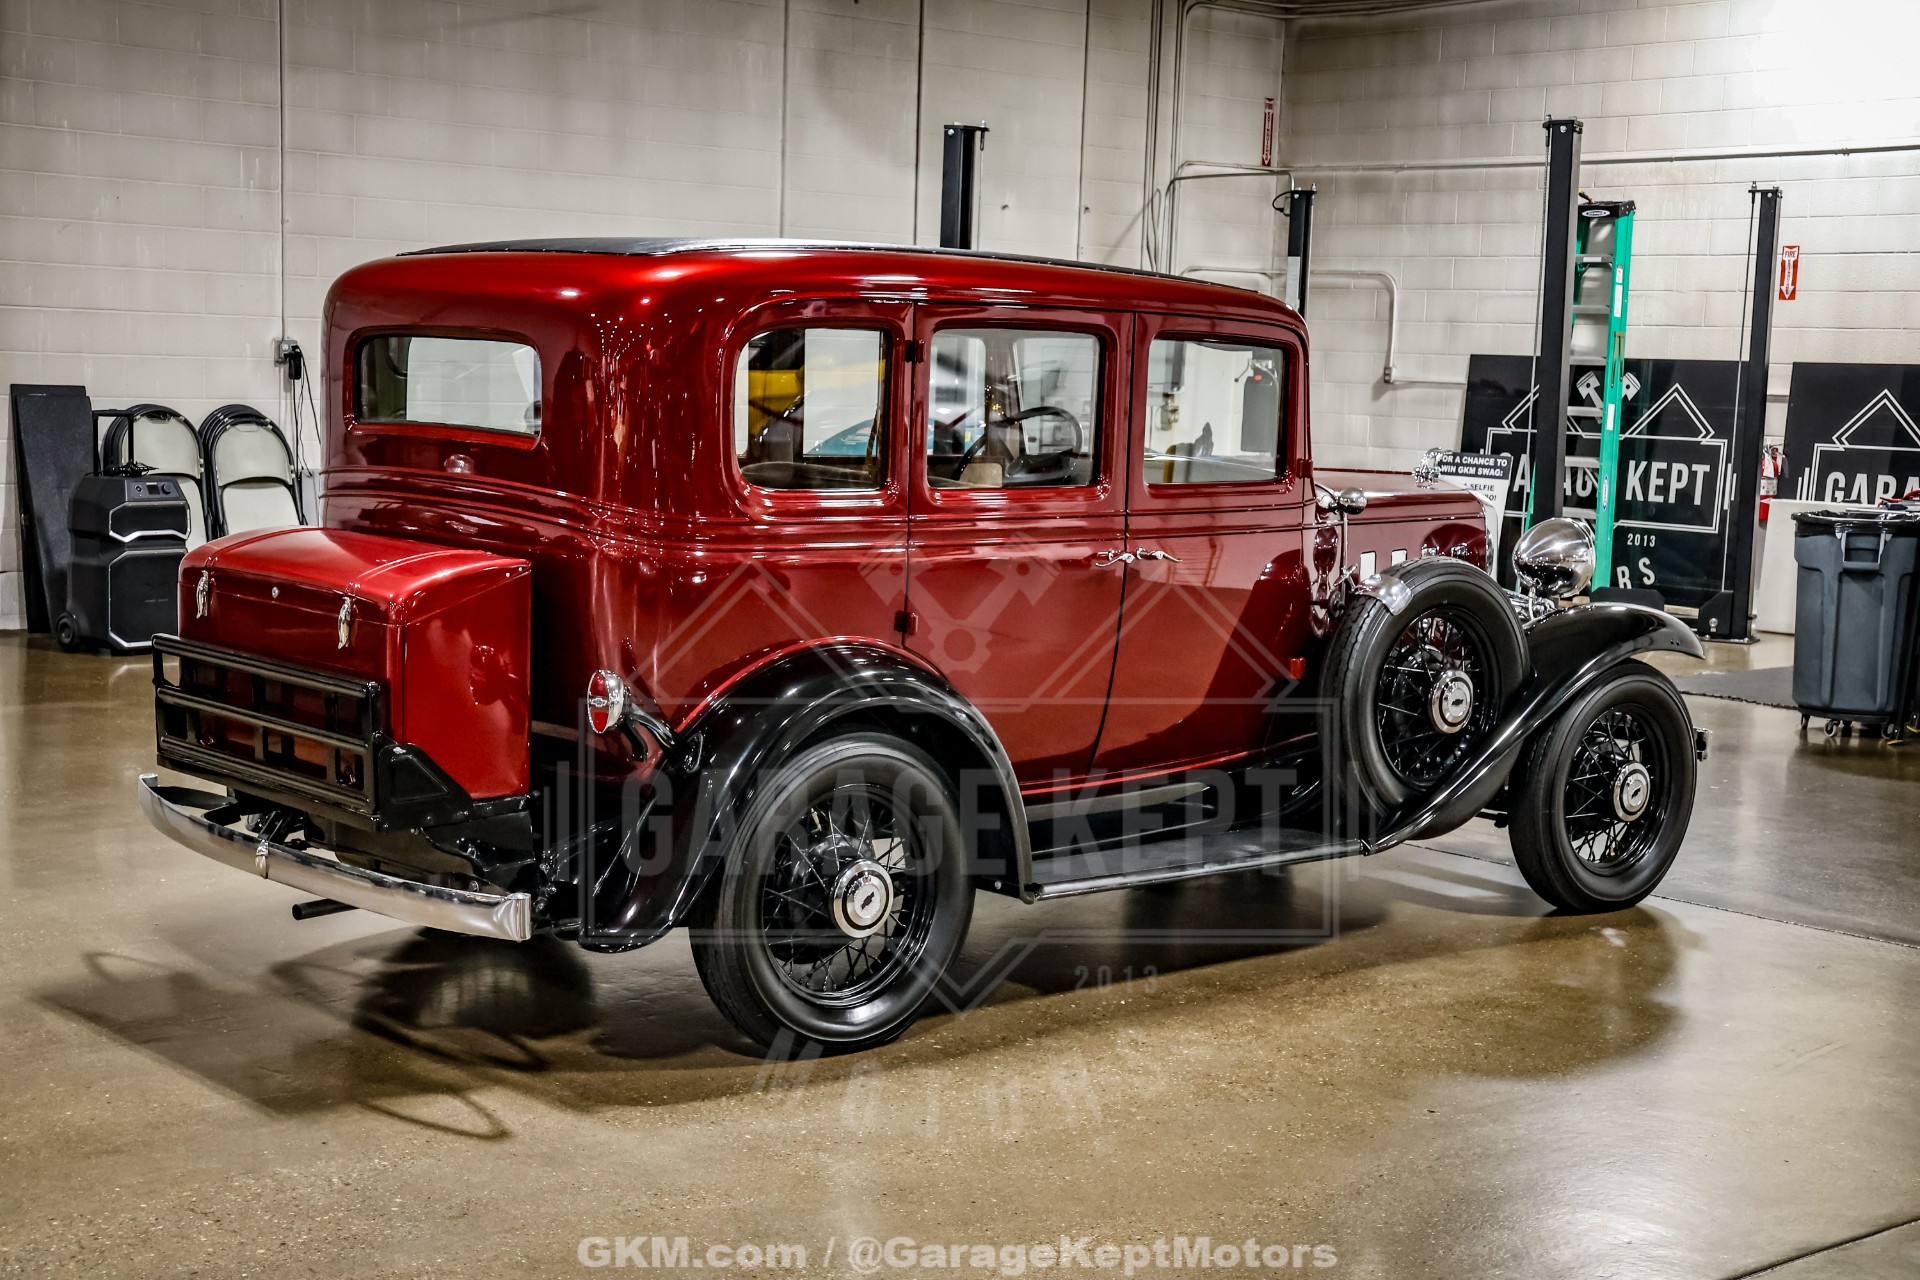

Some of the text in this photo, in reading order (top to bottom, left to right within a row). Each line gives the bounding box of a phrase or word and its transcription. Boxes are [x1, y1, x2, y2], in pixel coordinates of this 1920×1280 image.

[1785, 250, 1796, 258] FIRE
[1462, 456, 1495, 466] CHANCE
[1496, 458, 1508, 467] TO
[1441, 465, 1456, 473] WIN
[1457, 466, 1476, 475] GKM
[1625, 460, 1711, 506] KEPT
[1626, 533, 1656, 548] 2013
